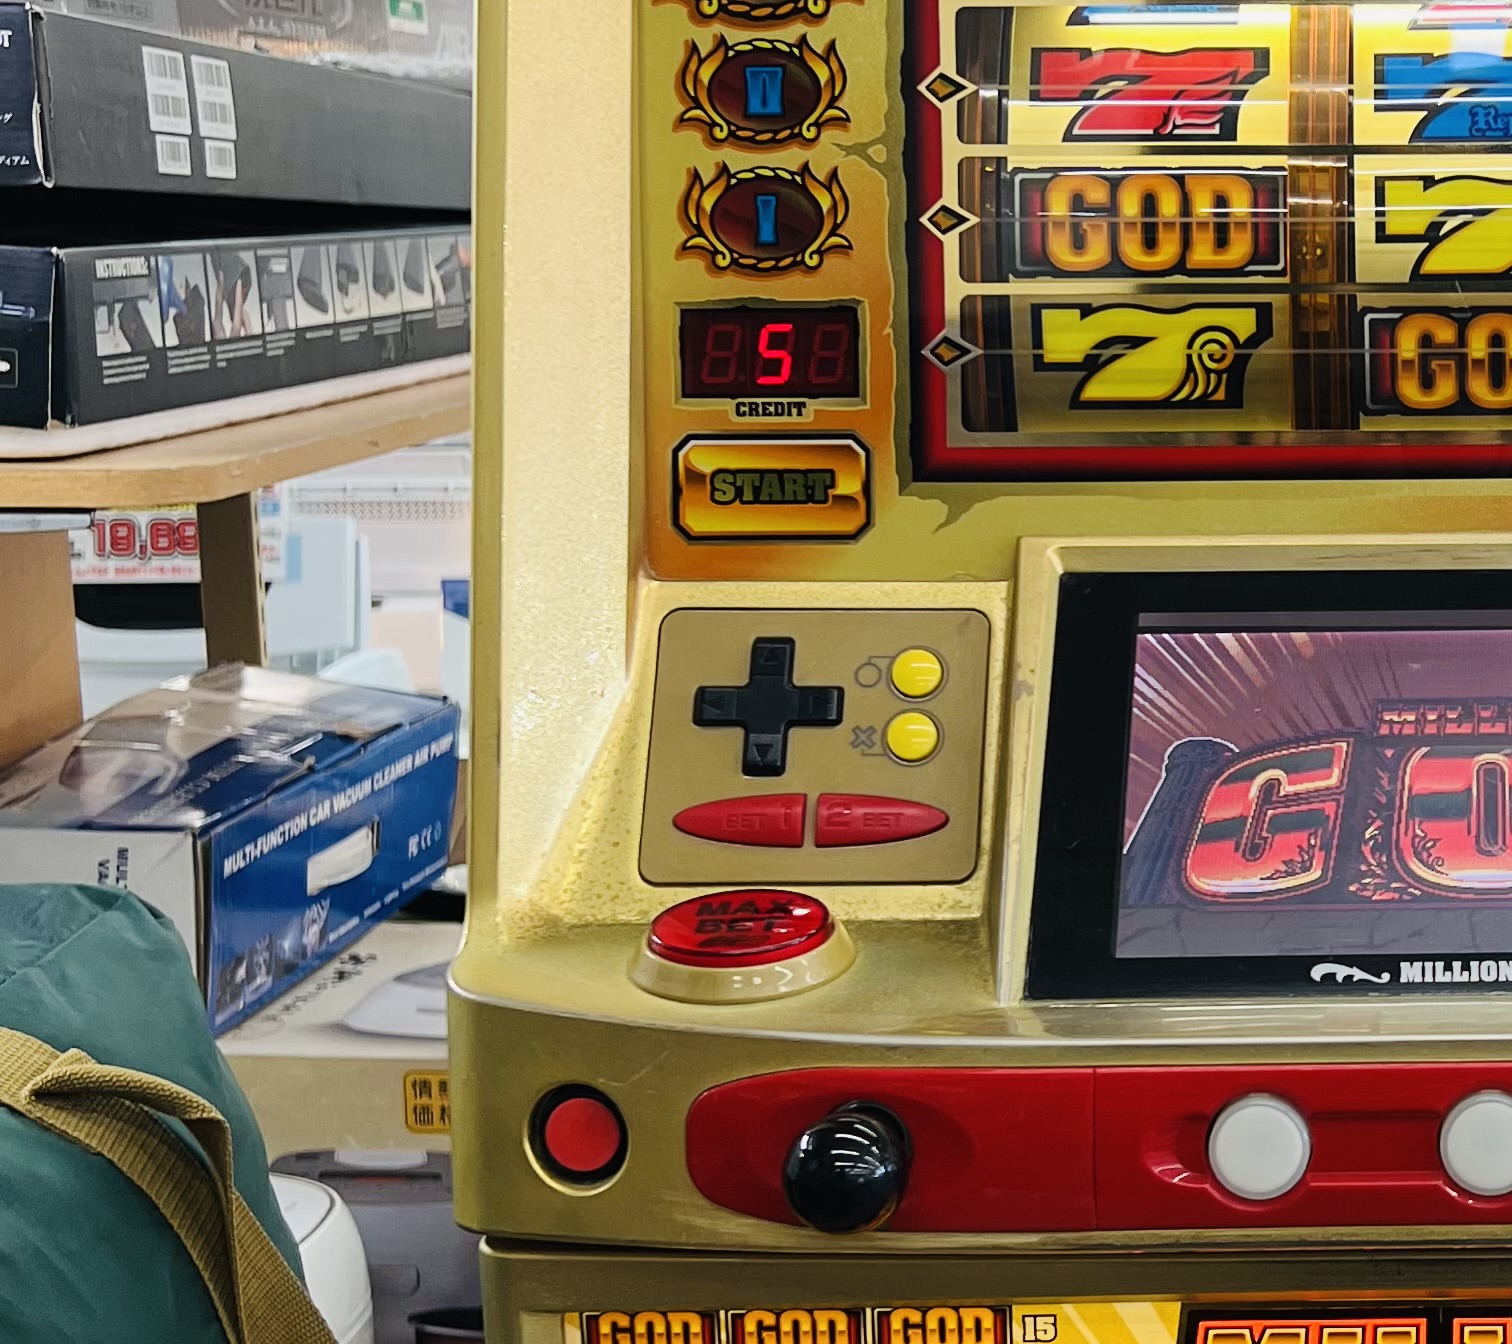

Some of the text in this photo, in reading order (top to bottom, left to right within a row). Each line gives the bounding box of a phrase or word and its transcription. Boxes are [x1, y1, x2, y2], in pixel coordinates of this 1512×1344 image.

[1030, 46, 1270, 142] 7
[1045, 174, 1255, 272] GOD
[757, 323, 793, 385] 5
[1031, 302, 1273, 410] 7
[735, 401, 807, 418] CREDIT
[711, 471, 834, 504] START
[224, 732, 453, 879] MULTI-FUNCTION CAR VACUUM CLEANER AIR PUMP
[825, 801, 904, 830] 2 BET
[724, 814, 768, 830] BET
[696, 899, 796, 917] MAX
[695, 917, 780, 934] BET
[1022, 1313, 1058, 1343] 15
